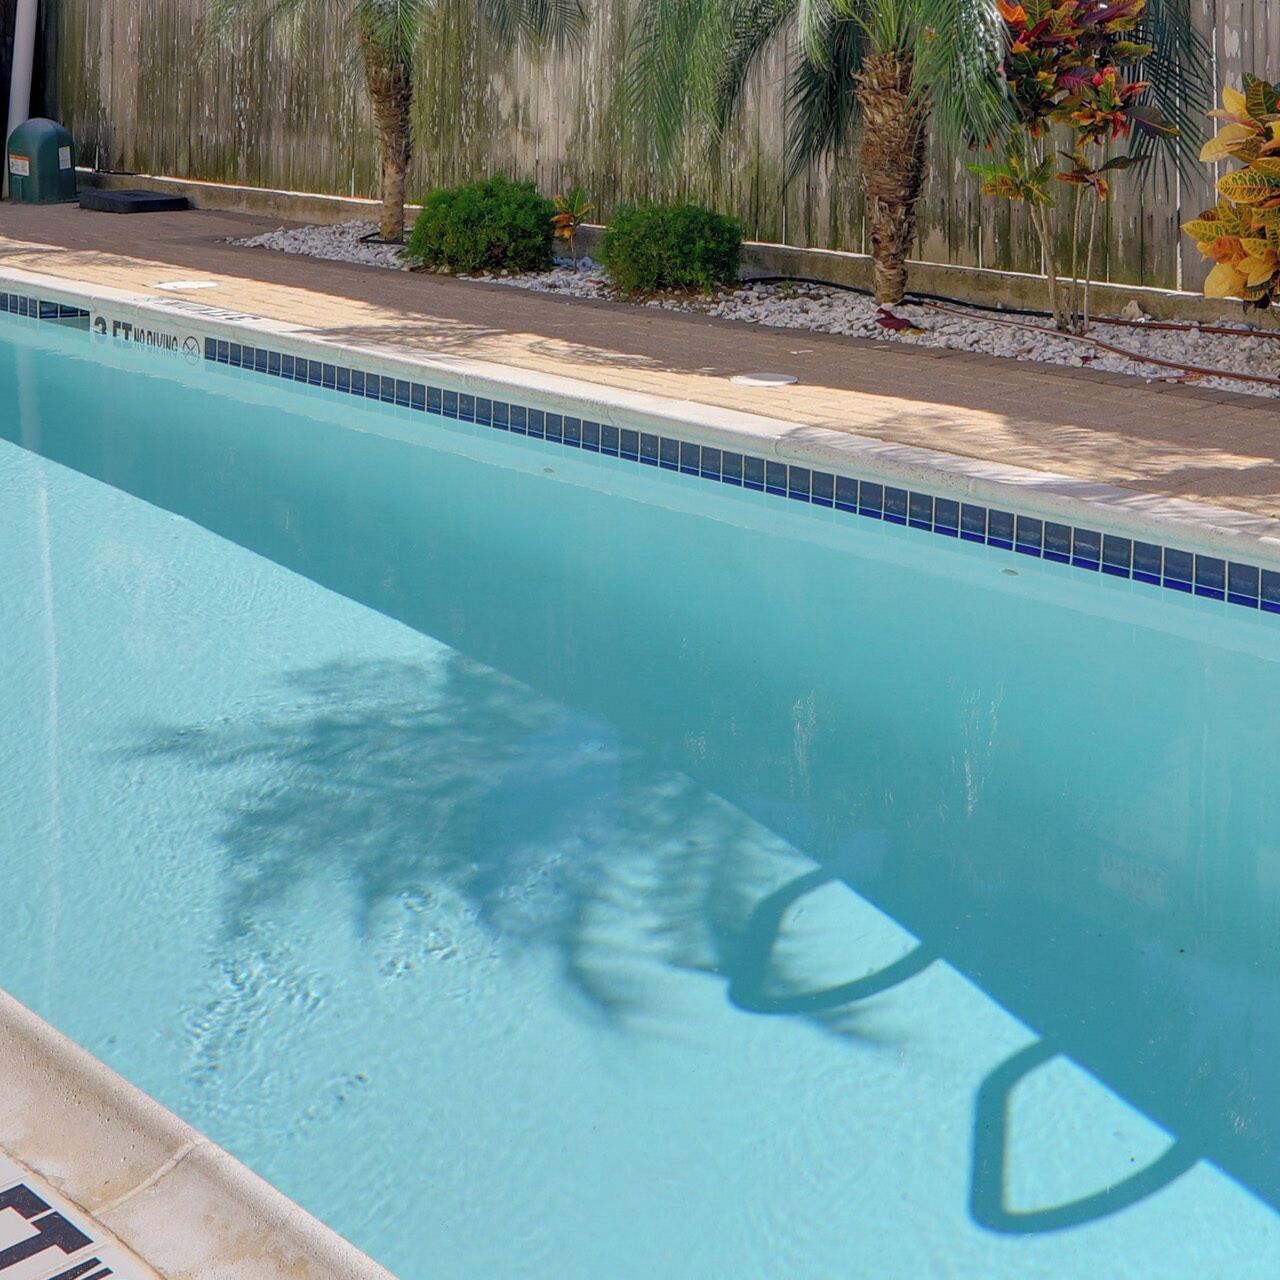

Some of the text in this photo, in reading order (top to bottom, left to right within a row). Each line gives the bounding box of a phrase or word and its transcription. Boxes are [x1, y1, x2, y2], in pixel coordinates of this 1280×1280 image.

[93, 316, 107, 335] 3
[134, 328, 146, 345] NO
[147, 330, 179, 352] DIVING
